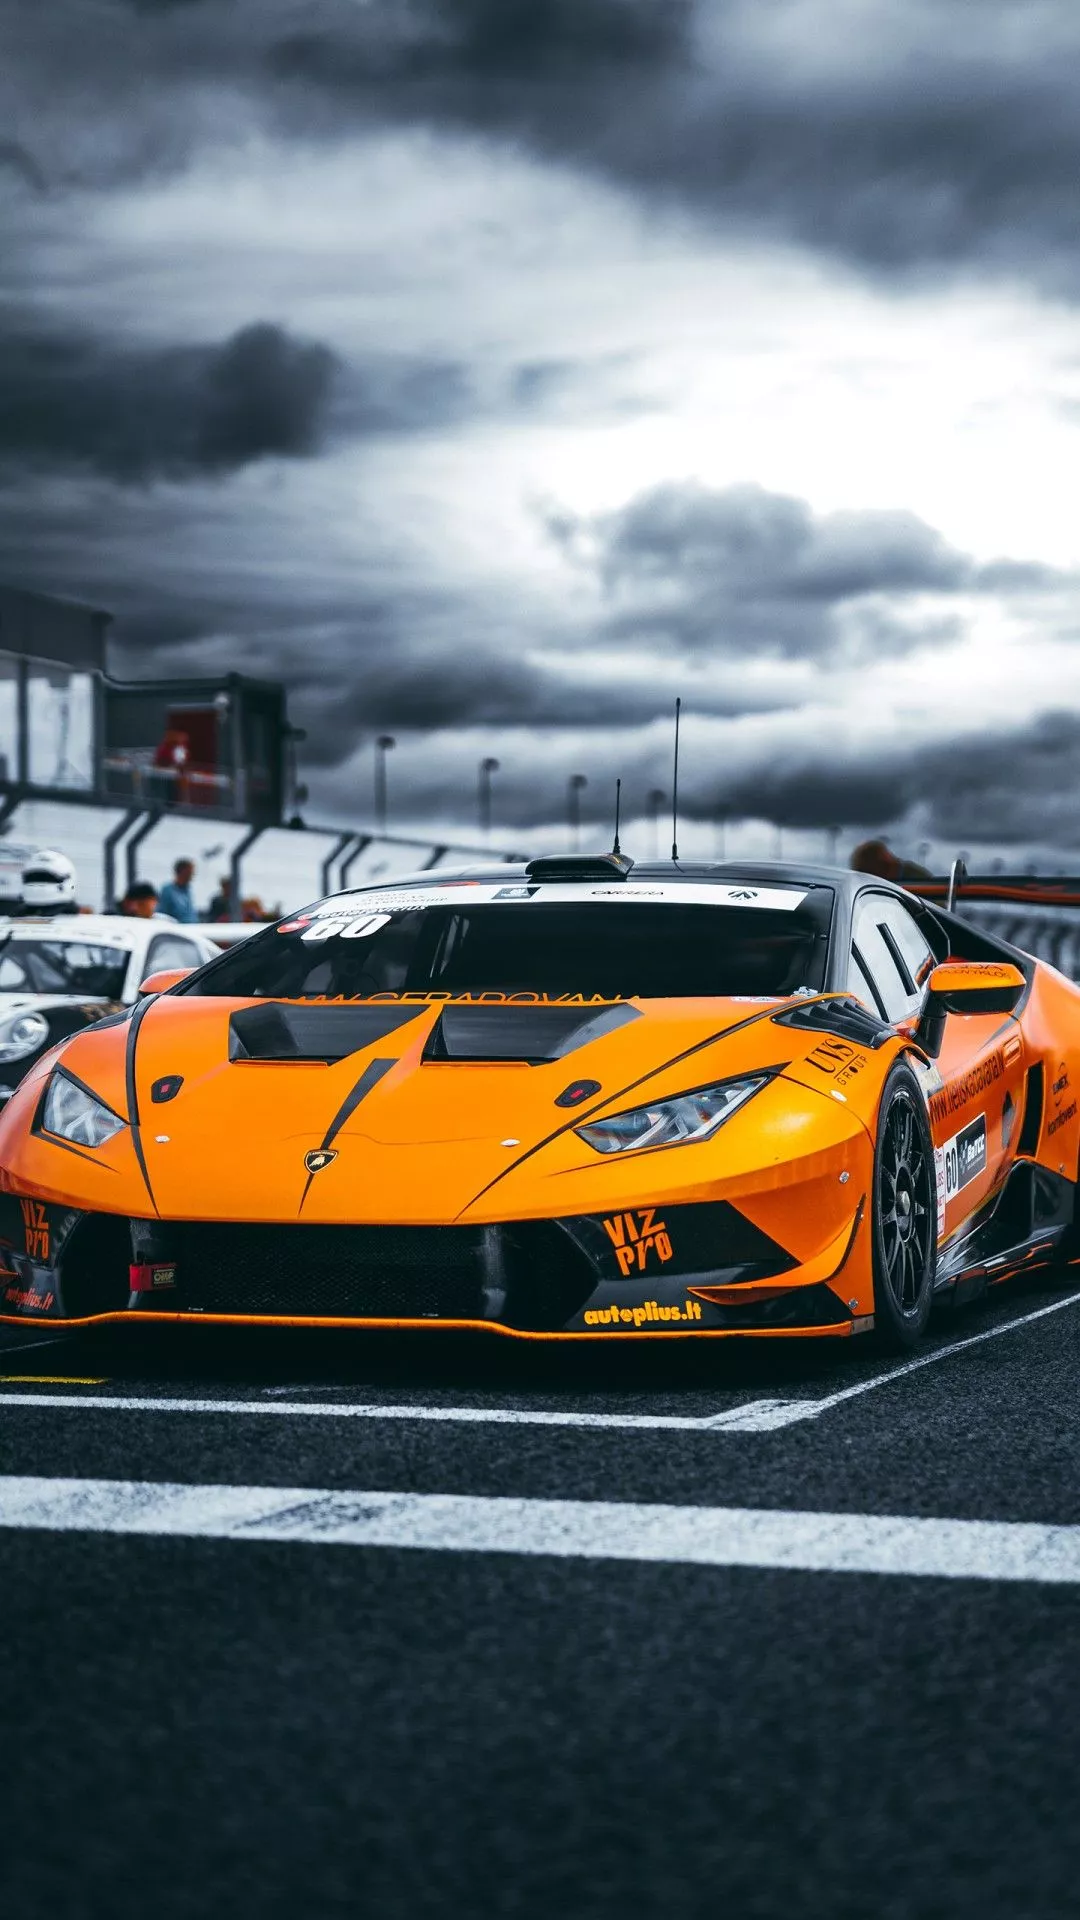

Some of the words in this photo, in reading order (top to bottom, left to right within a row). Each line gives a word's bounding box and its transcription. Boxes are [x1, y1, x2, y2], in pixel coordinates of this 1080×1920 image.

[300, 914, 392, 941] 60
[945, 1147, 958, 1194] 60
[603, 1208, 666, 1248] VIZ
[584, 1300, 702, 1327] autoplius.lt
